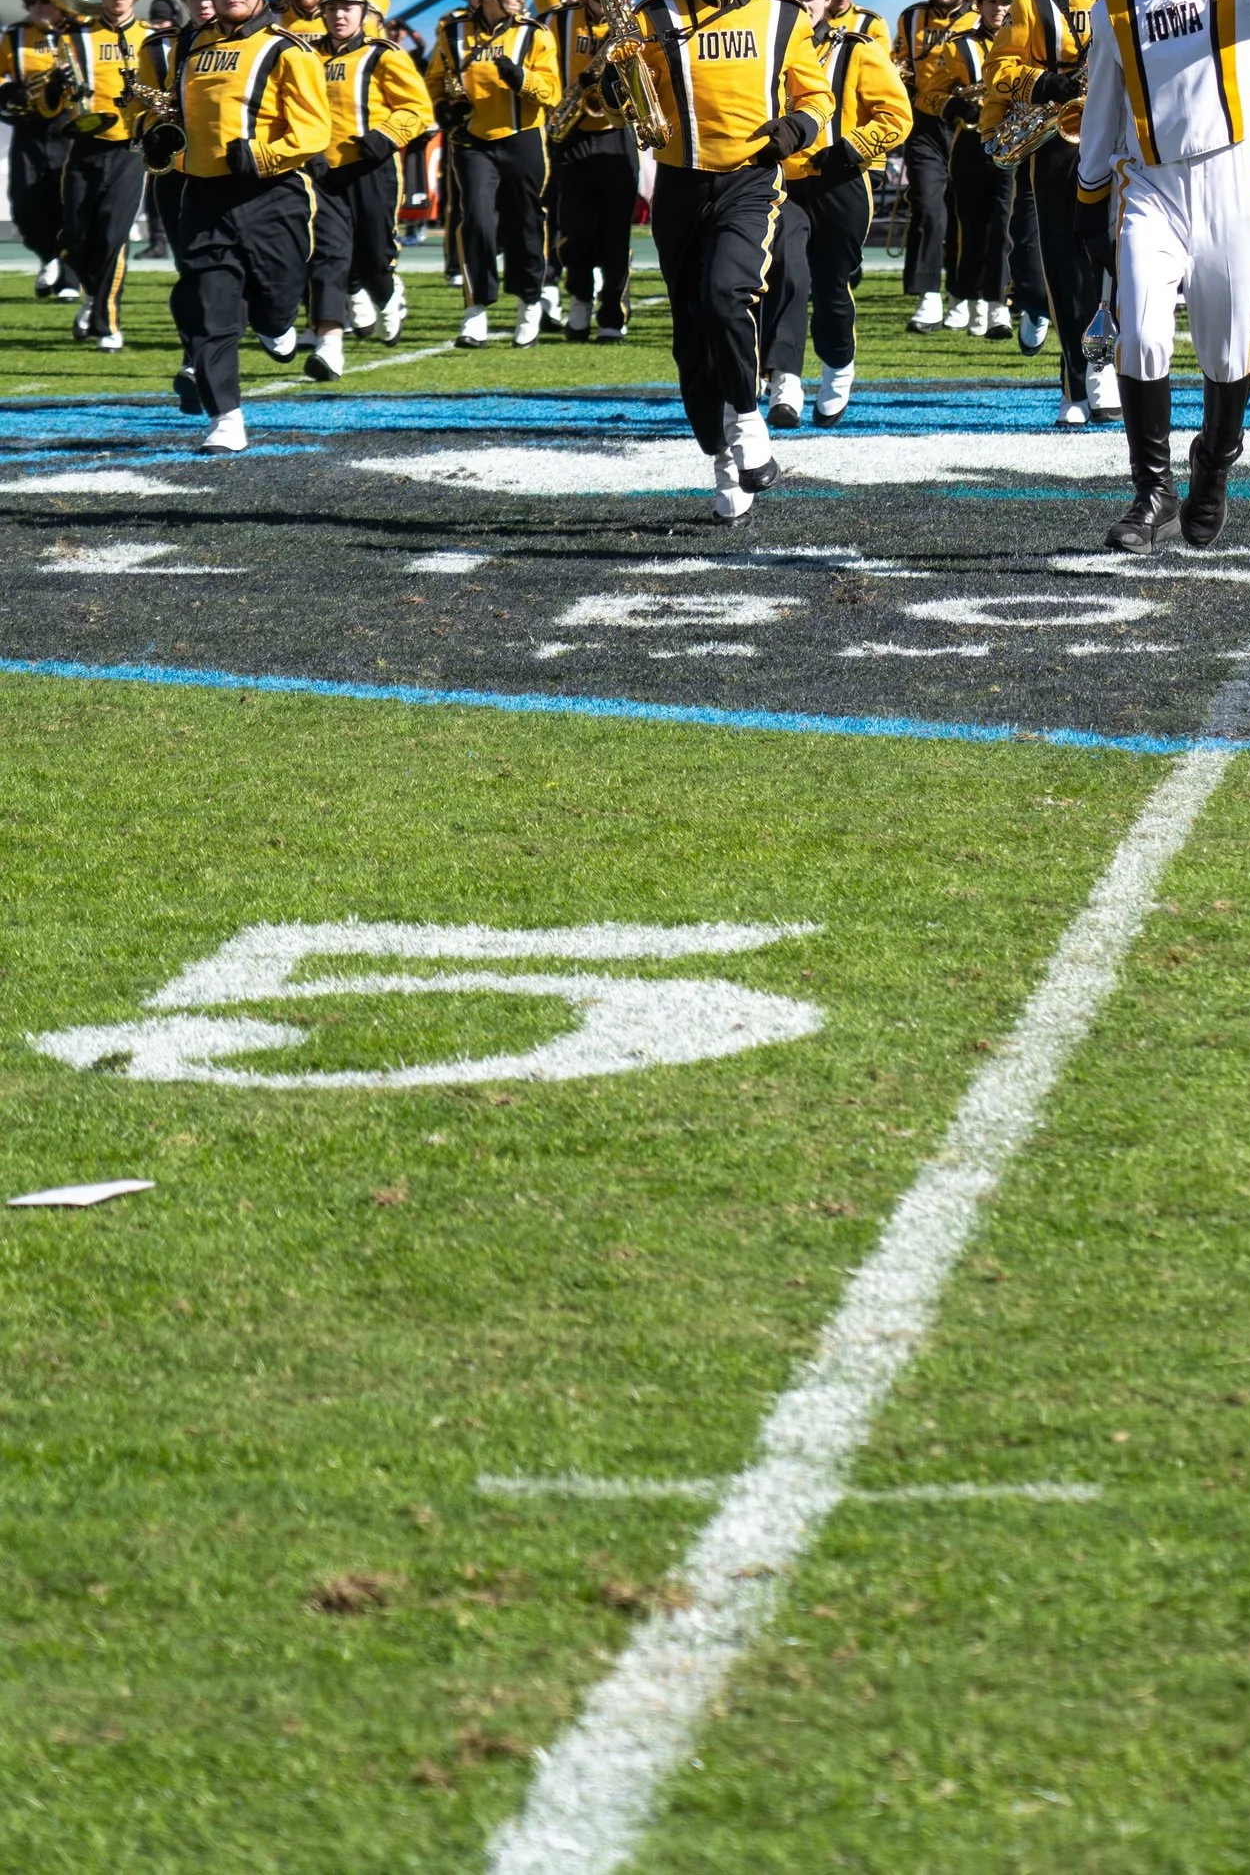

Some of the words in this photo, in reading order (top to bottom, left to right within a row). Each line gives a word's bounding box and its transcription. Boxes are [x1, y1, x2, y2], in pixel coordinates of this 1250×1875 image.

[1144, 2, 1204, 43] IOWA
[194, 50, 240, 74] IOWA
[697, 29, 759, 61] IOWA
[27, 919, 826, 1089] 5
